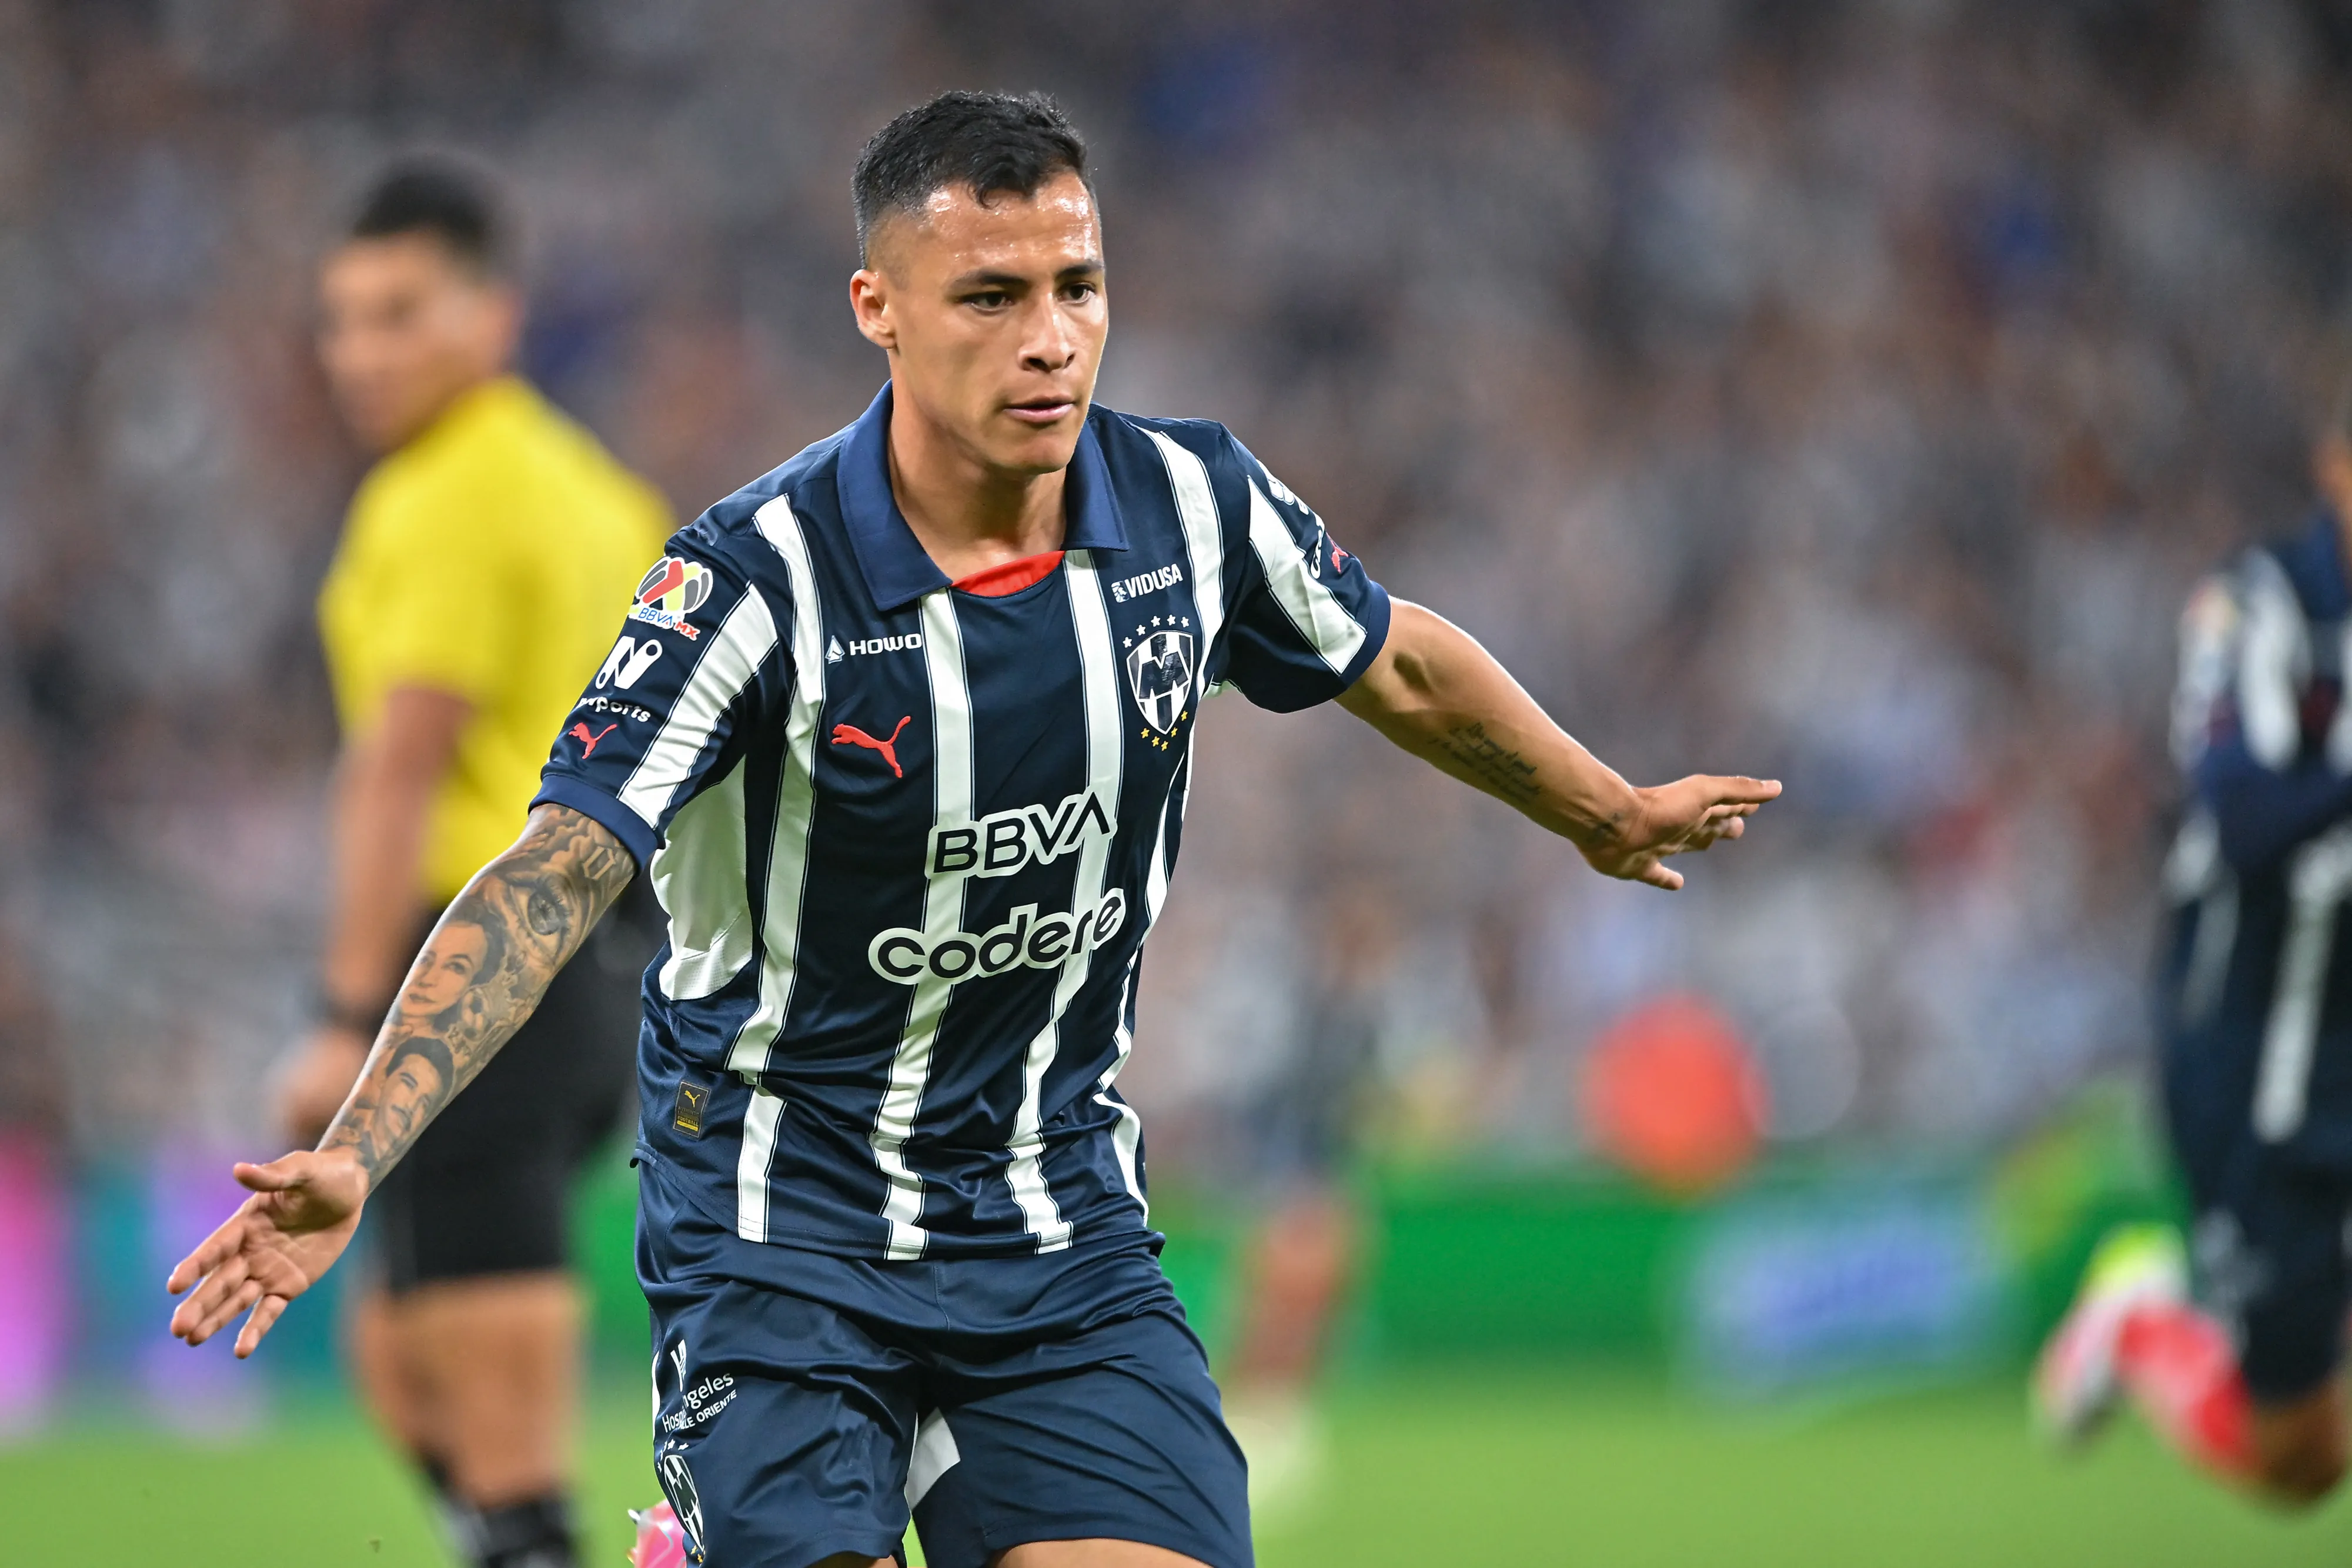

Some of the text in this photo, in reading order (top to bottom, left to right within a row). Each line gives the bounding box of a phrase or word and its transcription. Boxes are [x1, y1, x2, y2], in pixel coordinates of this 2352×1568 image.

[1124, 563, 1183, 598] VIDUSA
[639, 607, 697, 638] BBVA MX
[849, 633, 922, 656] HOWO
[933, 791, 1110, 874] BBVA
[877, 896, 1121, 979] codere
[682, 1373, 734, 1409] ngeles
[696, 1389, 737, 1422] ORIENTE
